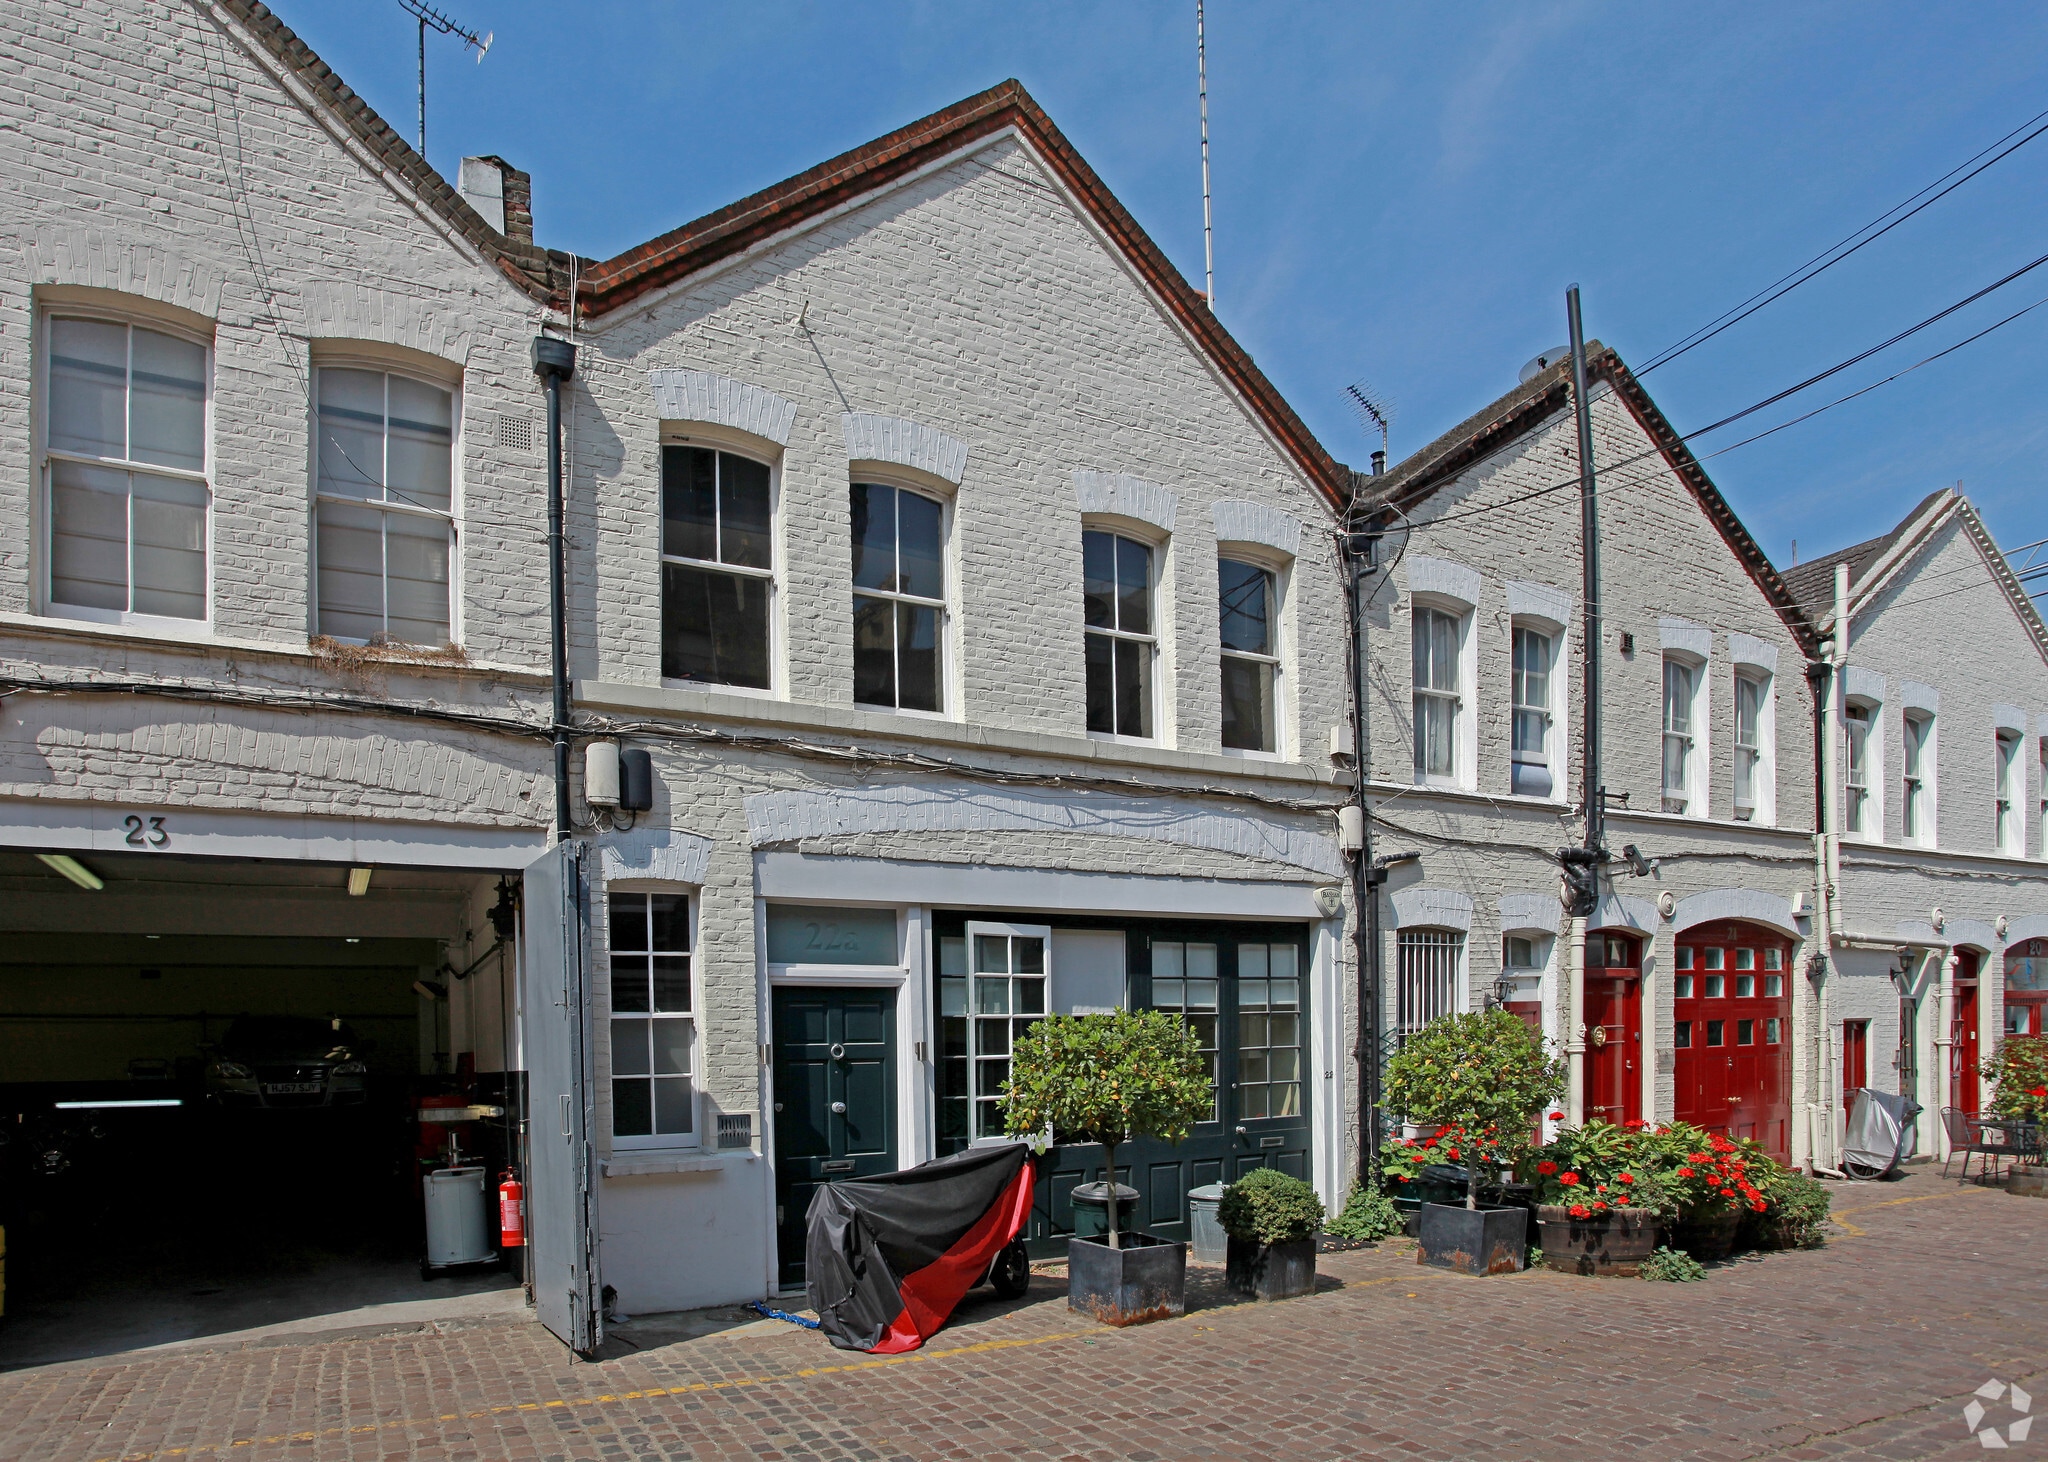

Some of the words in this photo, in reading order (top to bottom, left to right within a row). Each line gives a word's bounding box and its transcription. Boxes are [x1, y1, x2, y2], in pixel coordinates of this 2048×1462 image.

[124, 814, 169, 846] 23
[804, 922, 859, 951] 22a
[1727, 926, 1737, 940] 21
[2029, 941, 2042, 956] 20
[1324, 1070, 1334, 1079] 22
[271, 1083, 296, 1093] HJ57
[298, 1083, 317, 1092] SJY
